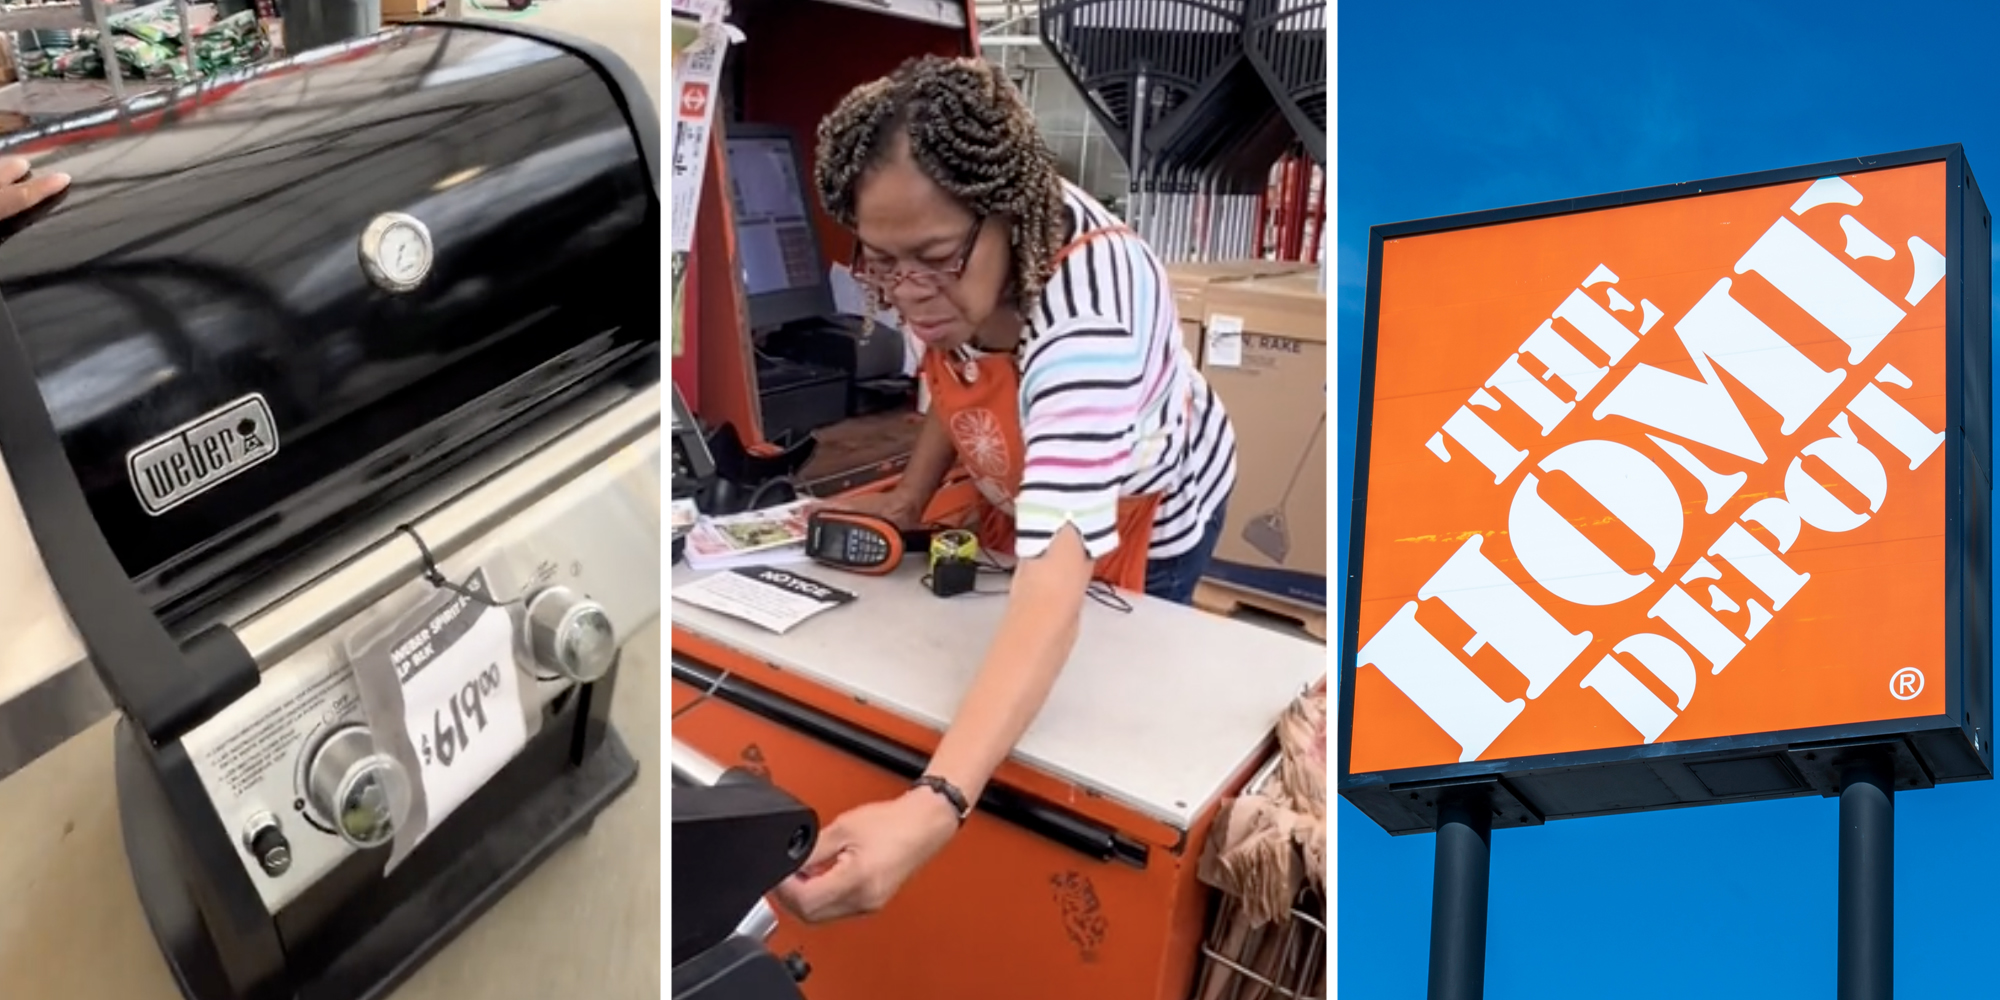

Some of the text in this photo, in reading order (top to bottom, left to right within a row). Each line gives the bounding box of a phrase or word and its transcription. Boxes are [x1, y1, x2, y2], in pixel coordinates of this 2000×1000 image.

[1260, 335, 1301, 353] RAKE
[1424, 263, 1665, 486] THE
[144, 428, 234, 498] weber
[1356, 176, 1946, 762] HOME
[1580, 362, 1946, 744] DEPOT
[759, 570, 832, 598] NOTICE
[391, 628, 431, 664] WEBER
[411, 642, 435, 667] BLK
